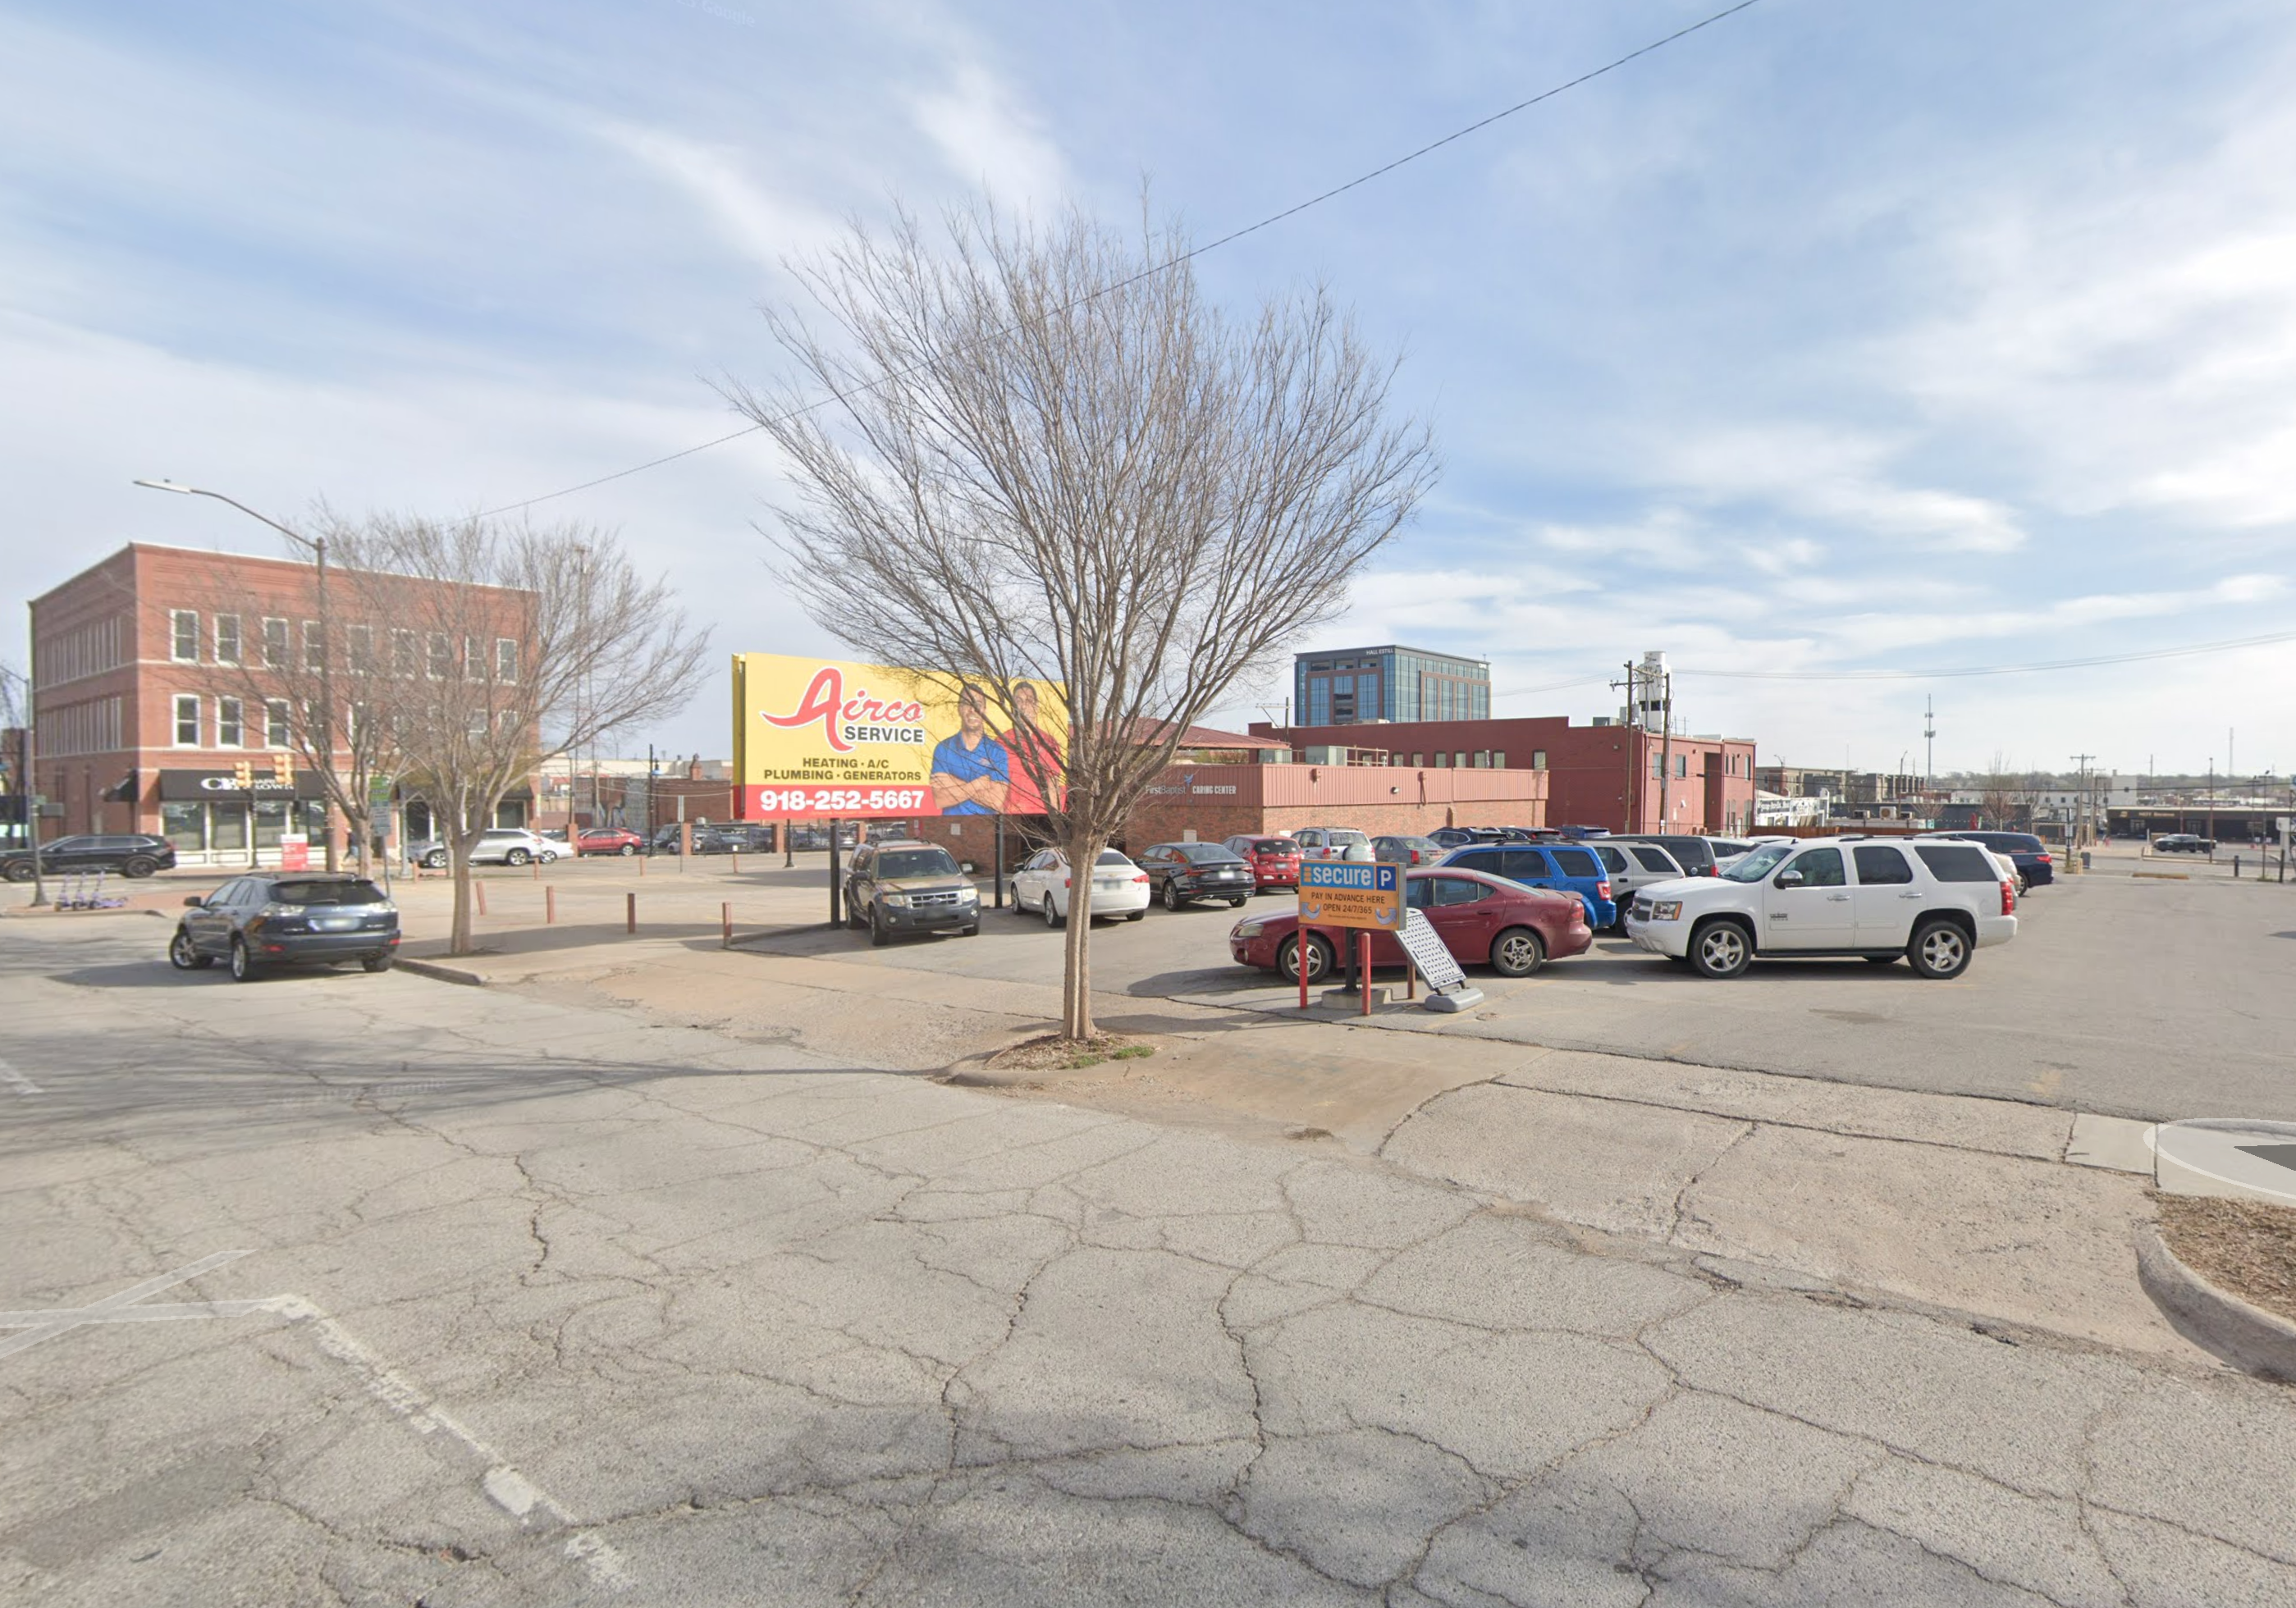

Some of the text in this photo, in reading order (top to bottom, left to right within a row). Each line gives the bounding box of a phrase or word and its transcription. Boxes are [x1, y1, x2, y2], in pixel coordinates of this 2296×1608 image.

[761, 667, 924, 751] Airco
[844, 726, 923, 742] SERVICE
[803, 757, 890, 769] HEATING A/C
[764, 770, 922, 781] PLUMBING GENERATORS
[1192, 785, 1214, 795] CARING
[1214, 785, 1237, 795] CENTER
[760, 790, 925, 811] 918-252-5667
[1313, 866, 1371, 886] secure
[1380, 870, 1392, 887] P
[1311, 892, 1323, 900] PAY
[1334, 893, 1364, 902] ADVANCE
[1366, 896, 1385, 904] HERE
[1323, 903, 1373, 914] OPEN 24/7/365
